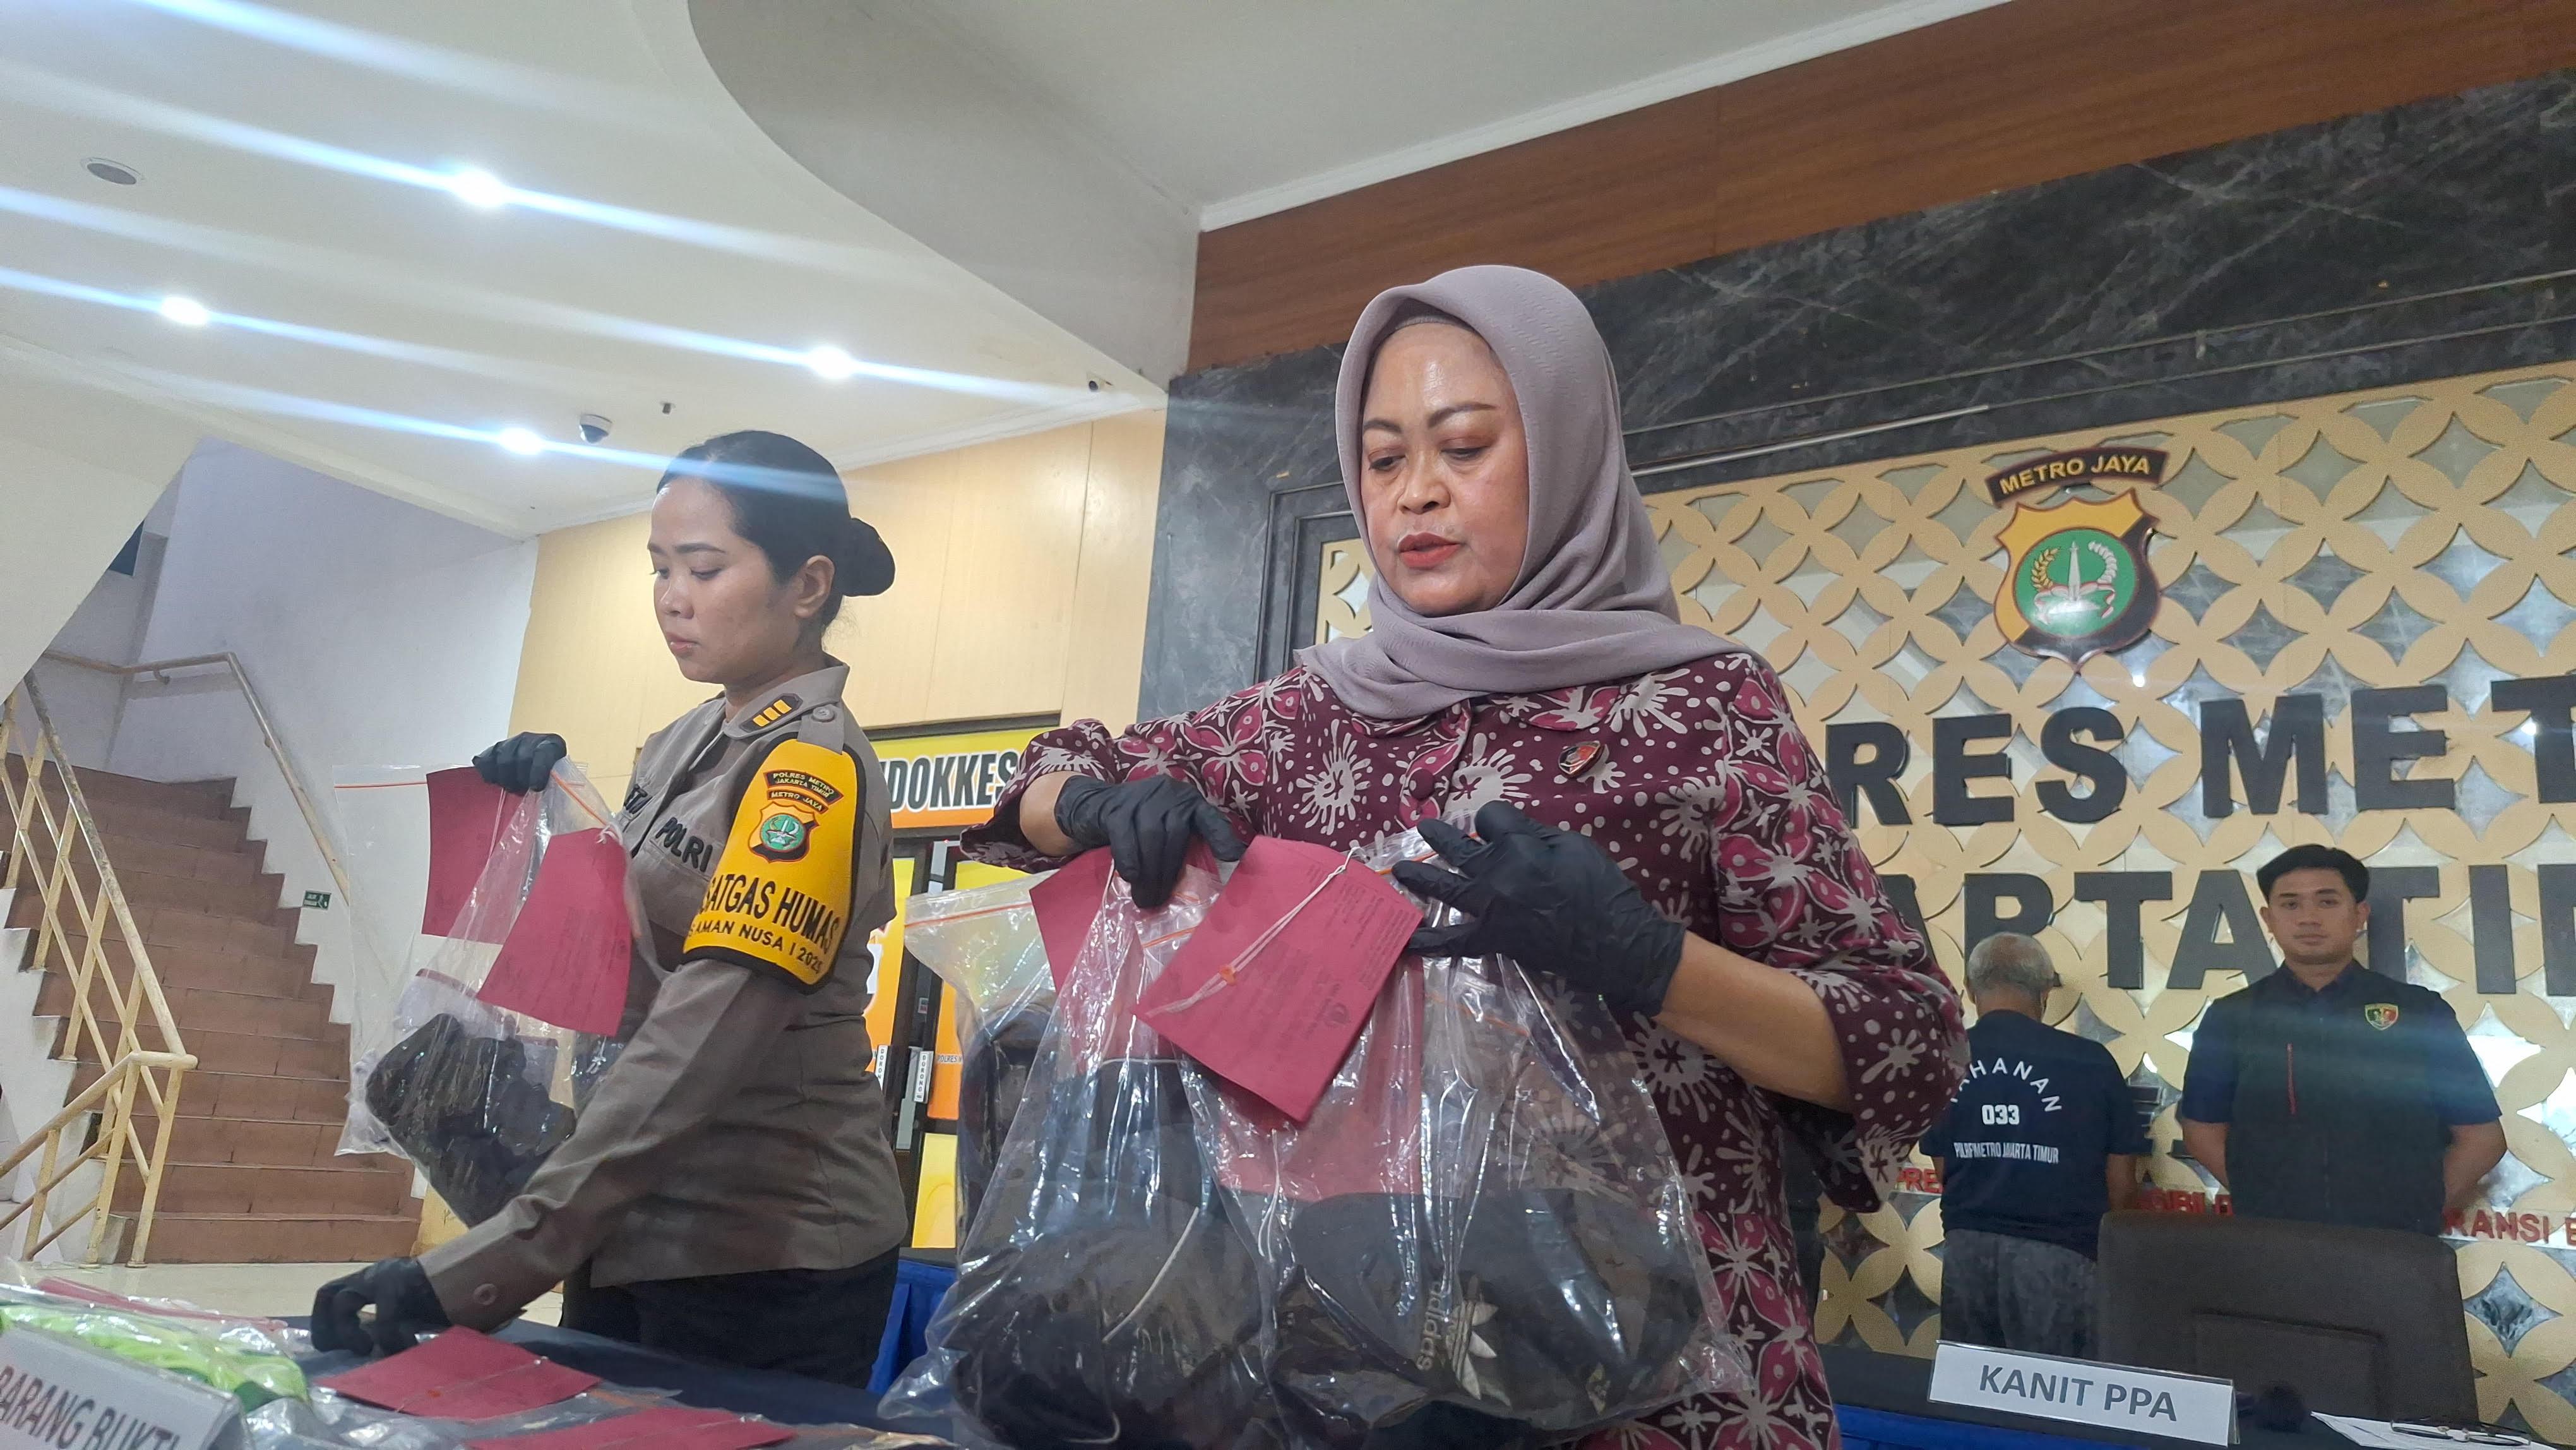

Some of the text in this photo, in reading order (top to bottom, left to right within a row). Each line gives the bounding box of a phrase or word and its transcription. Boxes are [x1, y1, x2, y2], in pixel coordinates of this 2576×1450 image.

[1999, 455, 2152, 494] METRO JAYA
[772, 772, 835, 794] POLRES METRO
[775, 778, 831, 798] JAKARTA TIMUR
[880, 752, 1018, 810] DOKKES
[771, 791, 823, 811] METRO JAYA
[655, 817, 713, 872] POLRI
[739, 923, 783, 951] NUSA
[772, 887, 840, 954] HUMAS
[918, 1055, 927, 1093] DORONG
[1950, 1057, 2063, 1112] HANAN
[1981, 1104, 2020, 1125] 033
[2032, 1144, 2060, 1164] TIMUR
[1979, 1365, 2177, 1422] KANIT PPA
